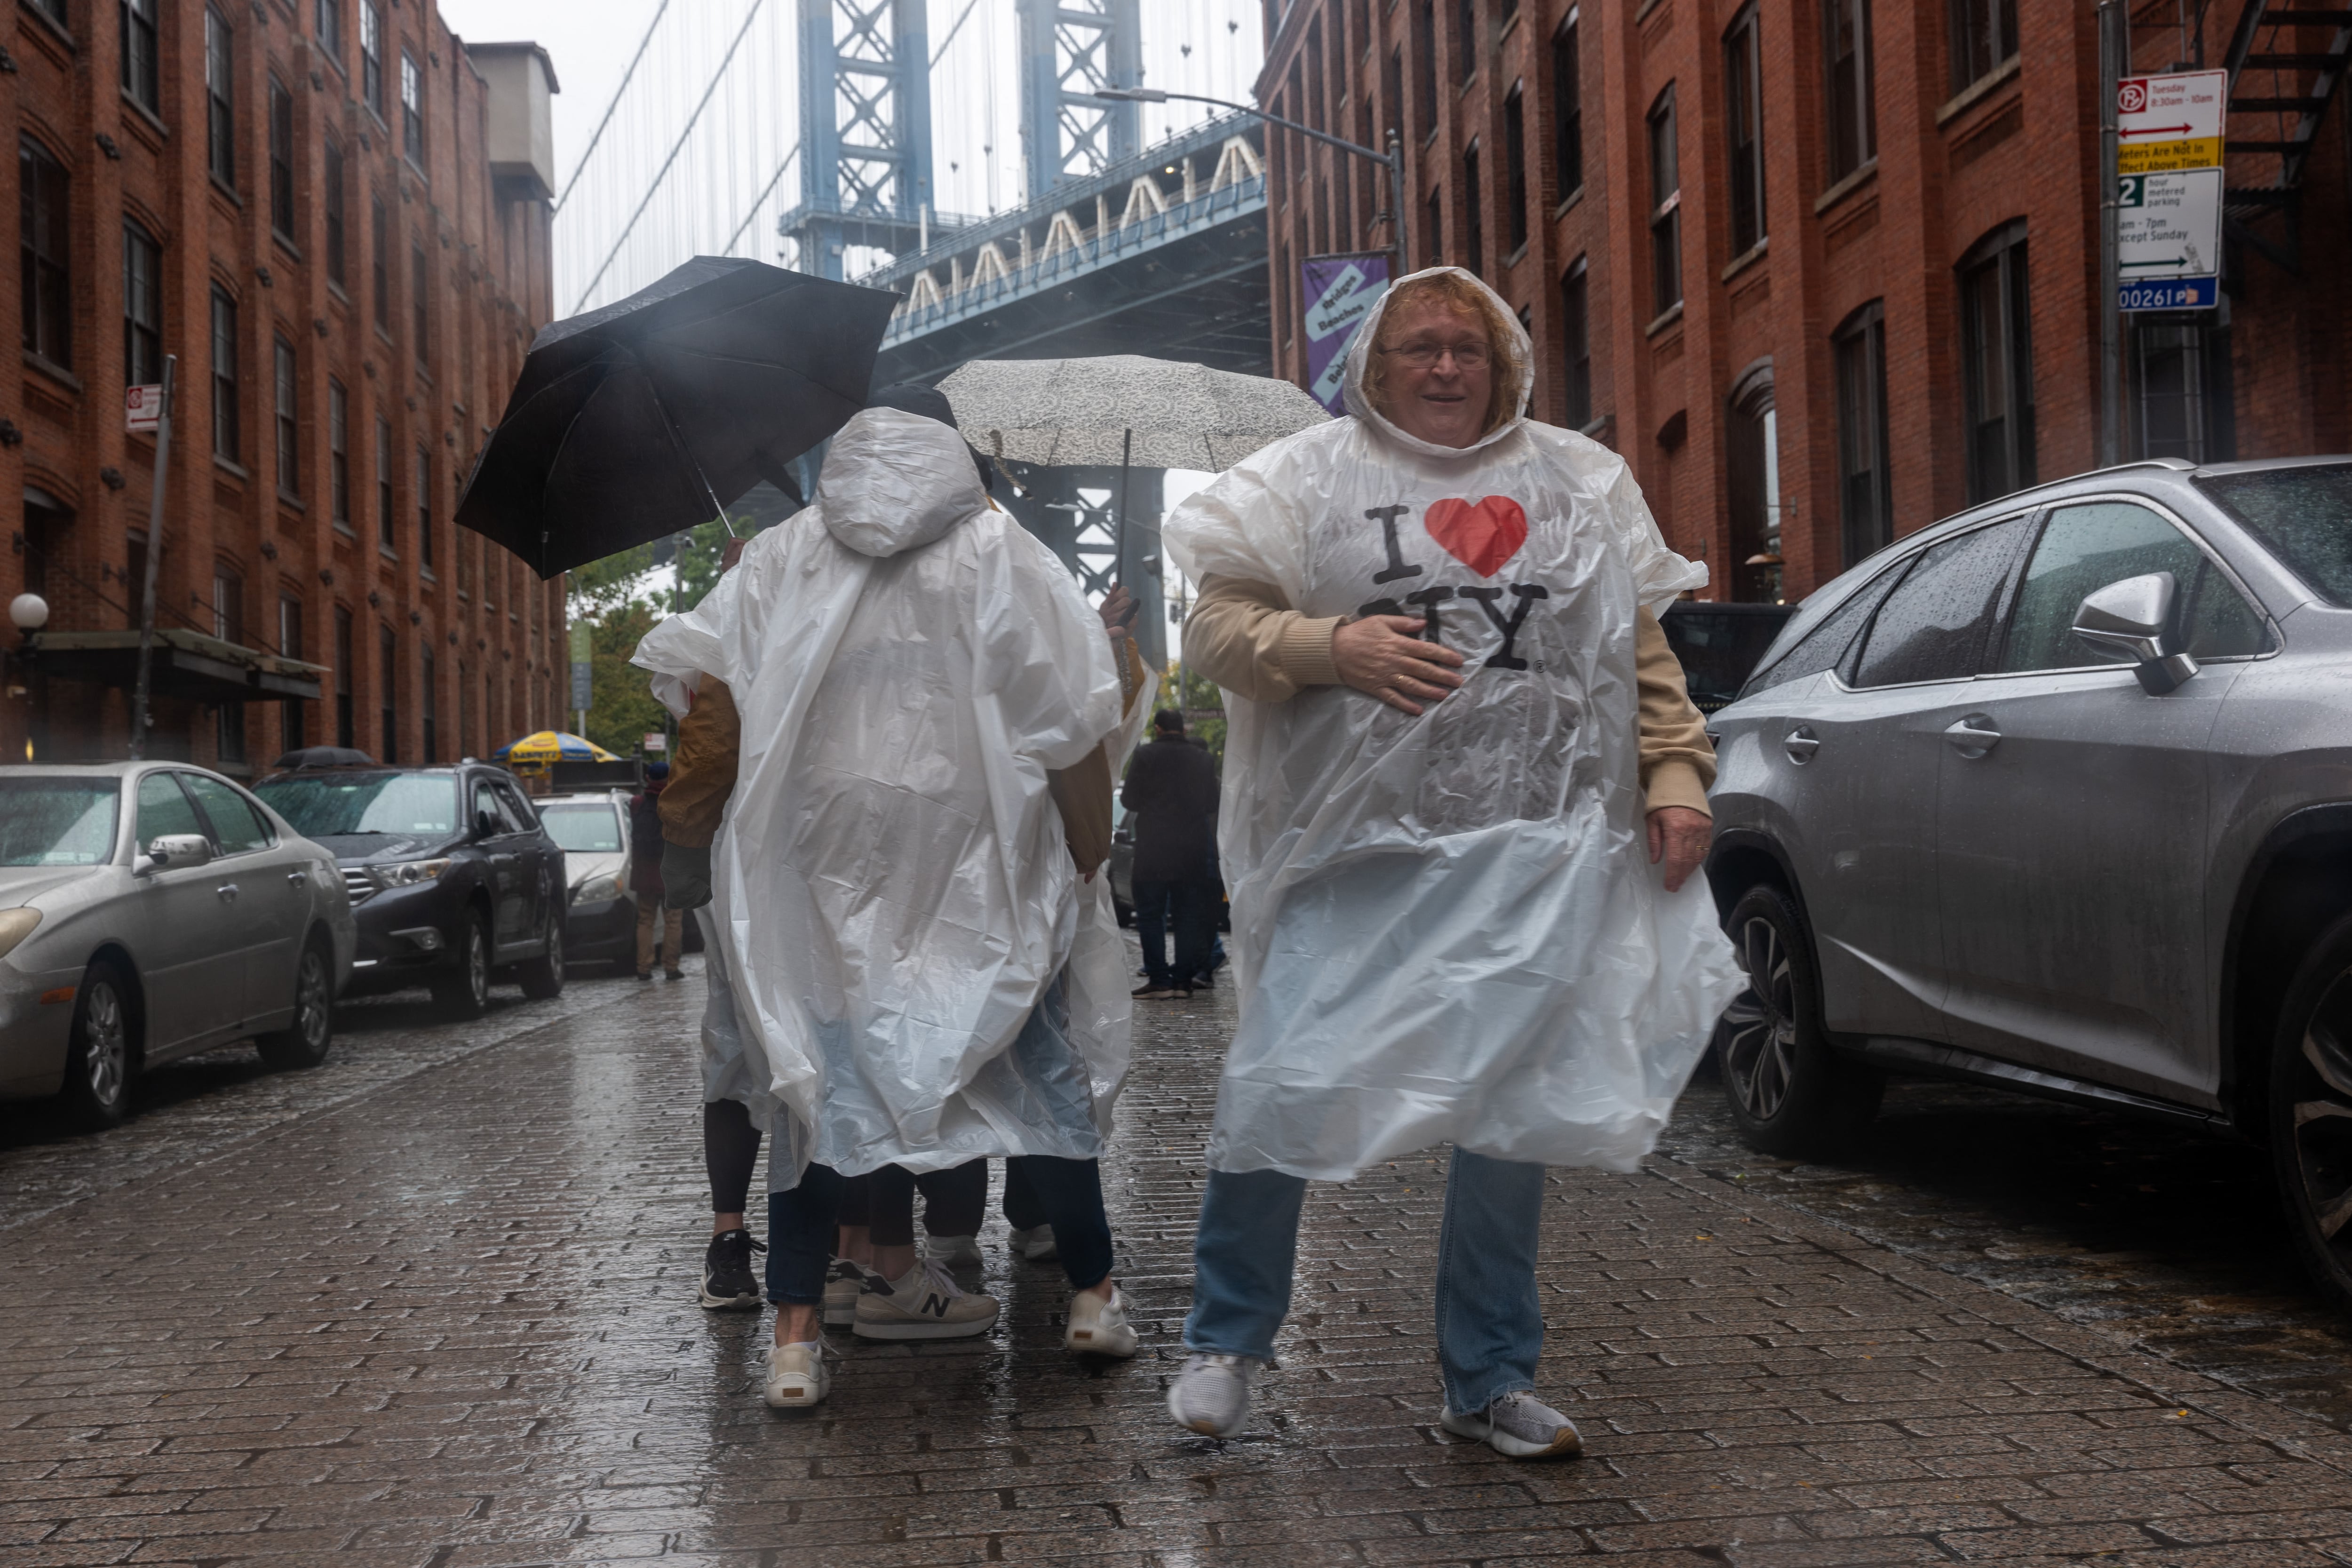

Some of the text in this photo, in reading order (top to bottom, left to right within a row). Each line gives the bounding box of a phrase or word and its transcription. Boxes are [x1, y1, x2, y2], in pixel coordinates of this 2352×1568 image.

[2151, 98, 2182, 107] 8:30am
[2152, 147, 2169, 156] Are
[2173, 144, 2191, 154] Not
[2119, 158, 2210, 173] ffect Above Times
[2119, 178, 2136, 206] 2
[2148, 187, 2185, 196] metered
[2147, 198, 2180, 207] parking
[2119, 221, 2134, 230] am
[2146, 218, 2166, 229] 7pm
[2119, 230, 2187, 243] xcept Sunday
[1322, 275, 1356, 310] Bridges
[1318, 304, 1364, 331] Beaches
[1365, 504, 1423, 584] I
[921, 1293, 951, 1318] N
